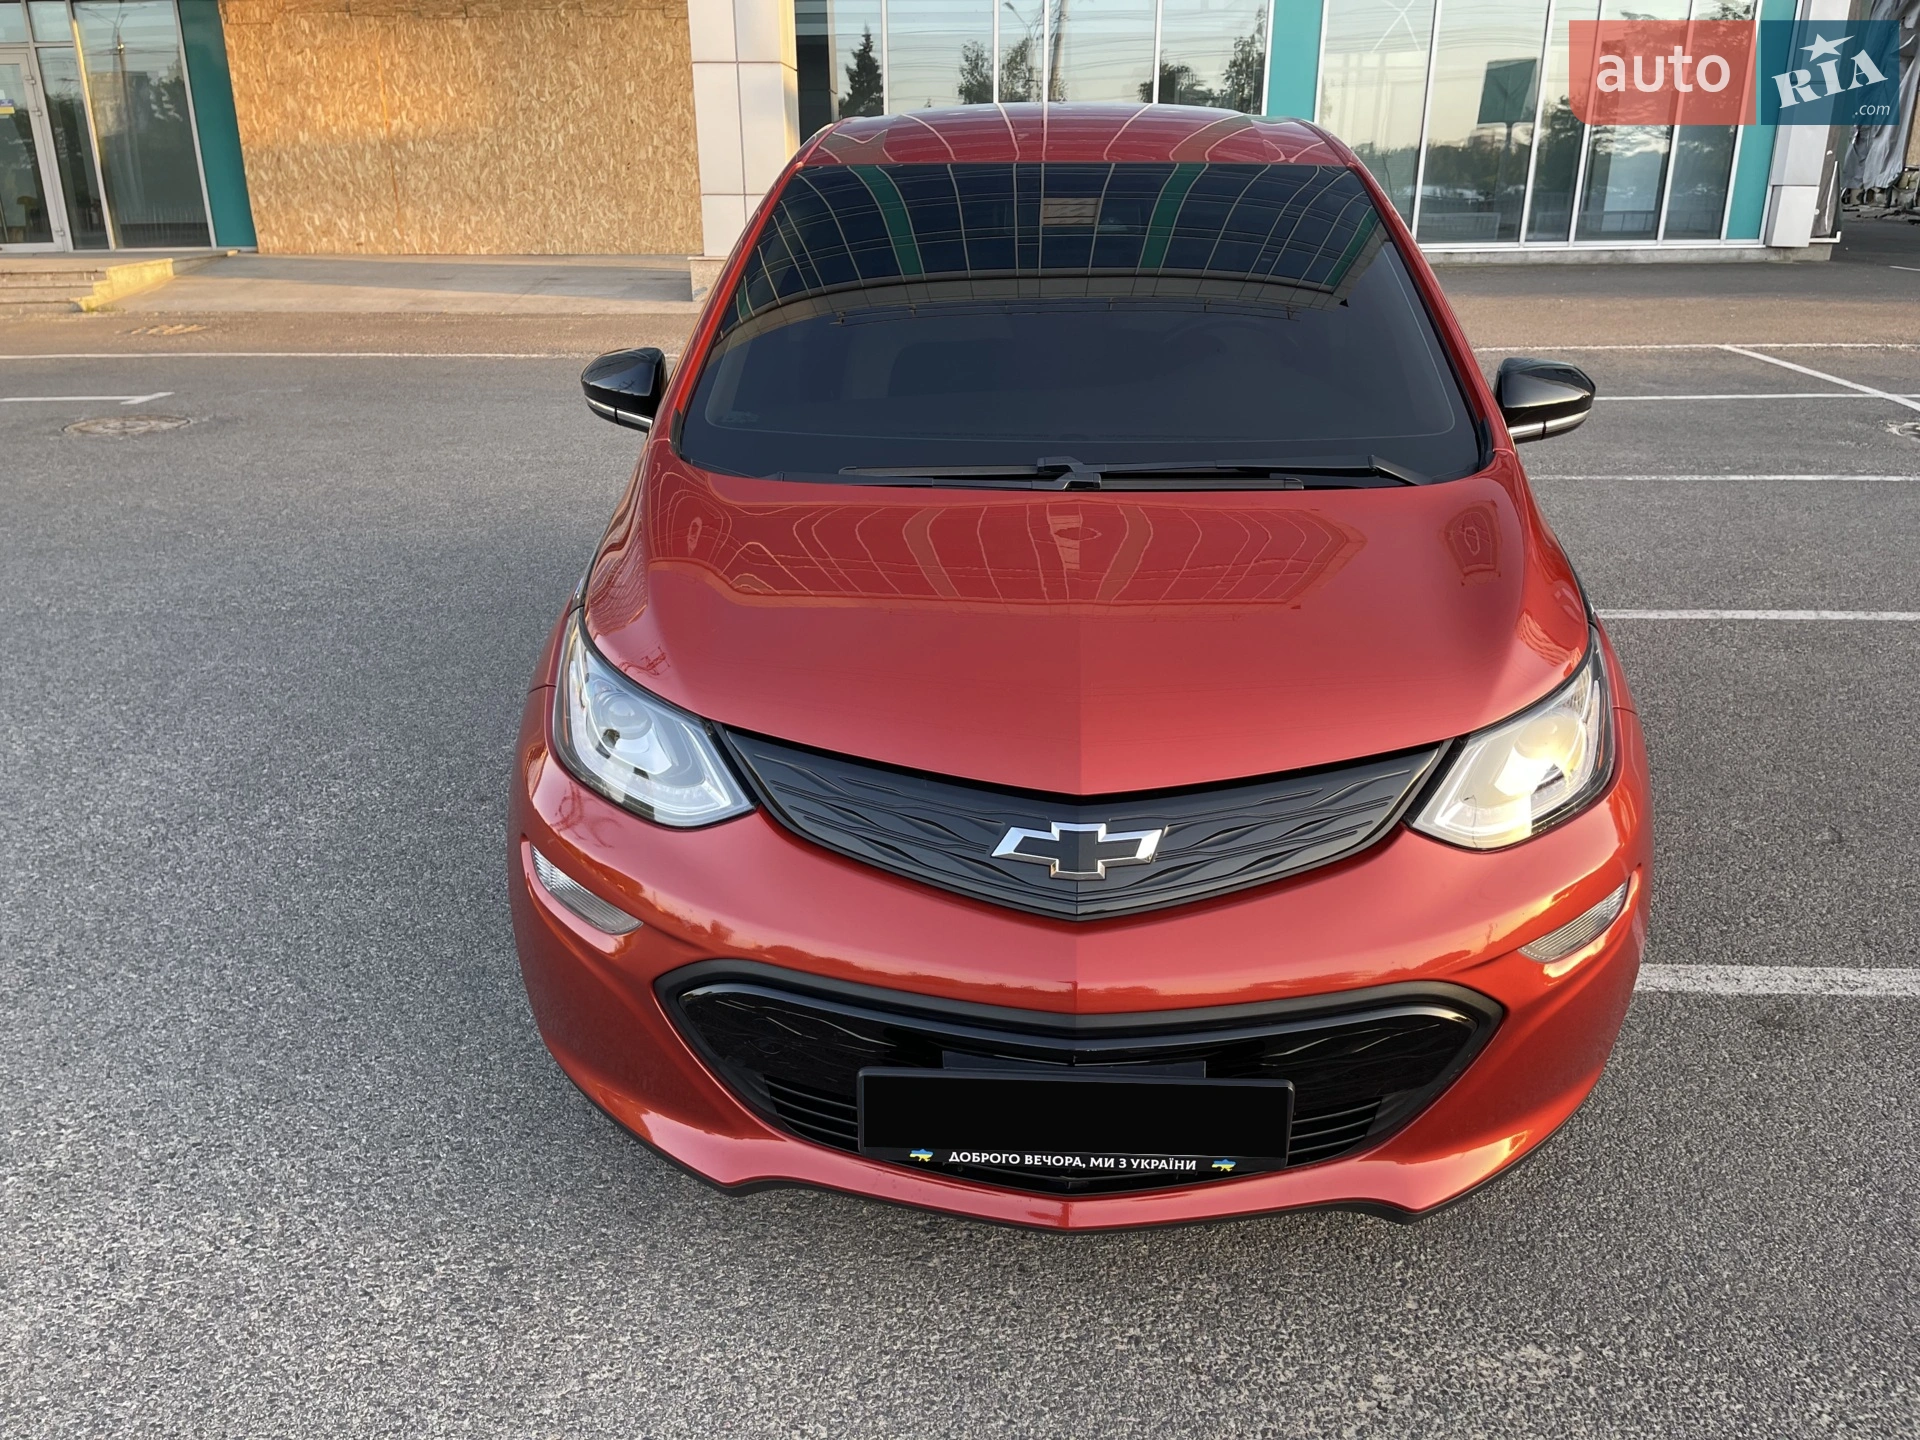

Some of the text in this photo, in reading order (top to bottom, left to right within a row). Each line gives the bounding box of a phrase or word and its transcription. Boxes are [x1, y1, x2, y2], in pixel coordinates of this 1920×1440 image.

[948, 1151, 1197, 1170] ДОБРОГО ВЕЧОРА, МИ З УКРАЇНИ
